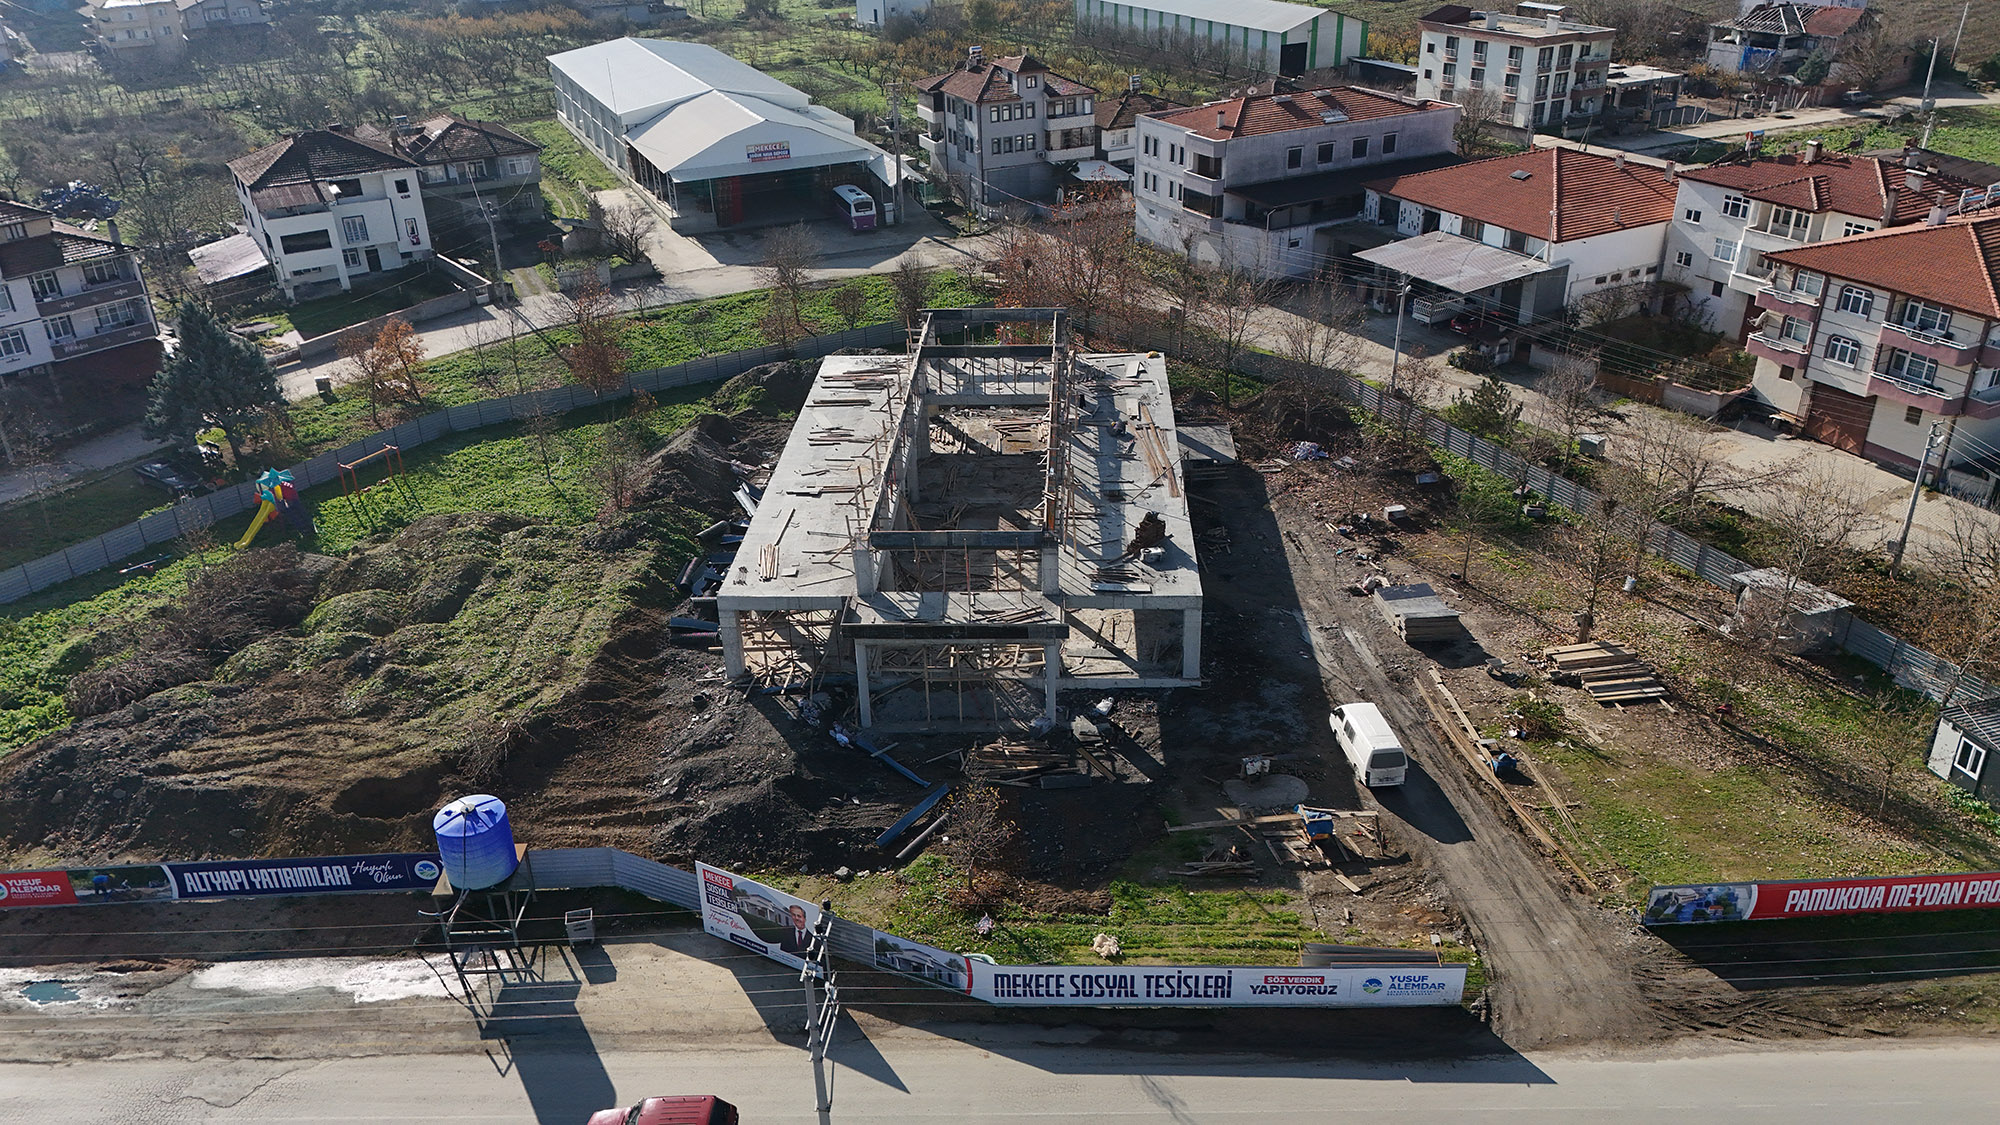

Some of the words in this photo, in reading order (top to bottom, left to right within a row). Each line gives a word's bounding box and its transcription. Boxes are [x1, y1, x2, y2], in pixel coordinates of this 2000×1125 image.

[755, 143, 780, 152] MEKECE
[6, 879, 41, 887] YUSUF
[183, 869, 250, 893] ALTYAPI
[249, 865, 352, 889] YATIRIMLARI
[704, 871, 731, 888] MEKECE
[10, 885, 61, 894] ALEMDAR
[706, 882, 730, 899] SOSYAL
[1784, 886, 1886, 912] PAMUKOVA
[1886, 881, 1966, 907] MEYDAN
[1964, 880, 2000, 904] PRO
[994, 973, 1065, 998] MEKECE
[1069, 974, 1139, 998] SOSYAL
[1143, 970, 1233, 998] TESİSLERİ
[1267, 976, 1287, 984] SÖZ
[1250, 985, 1338, 995] YAPIYORUZ
